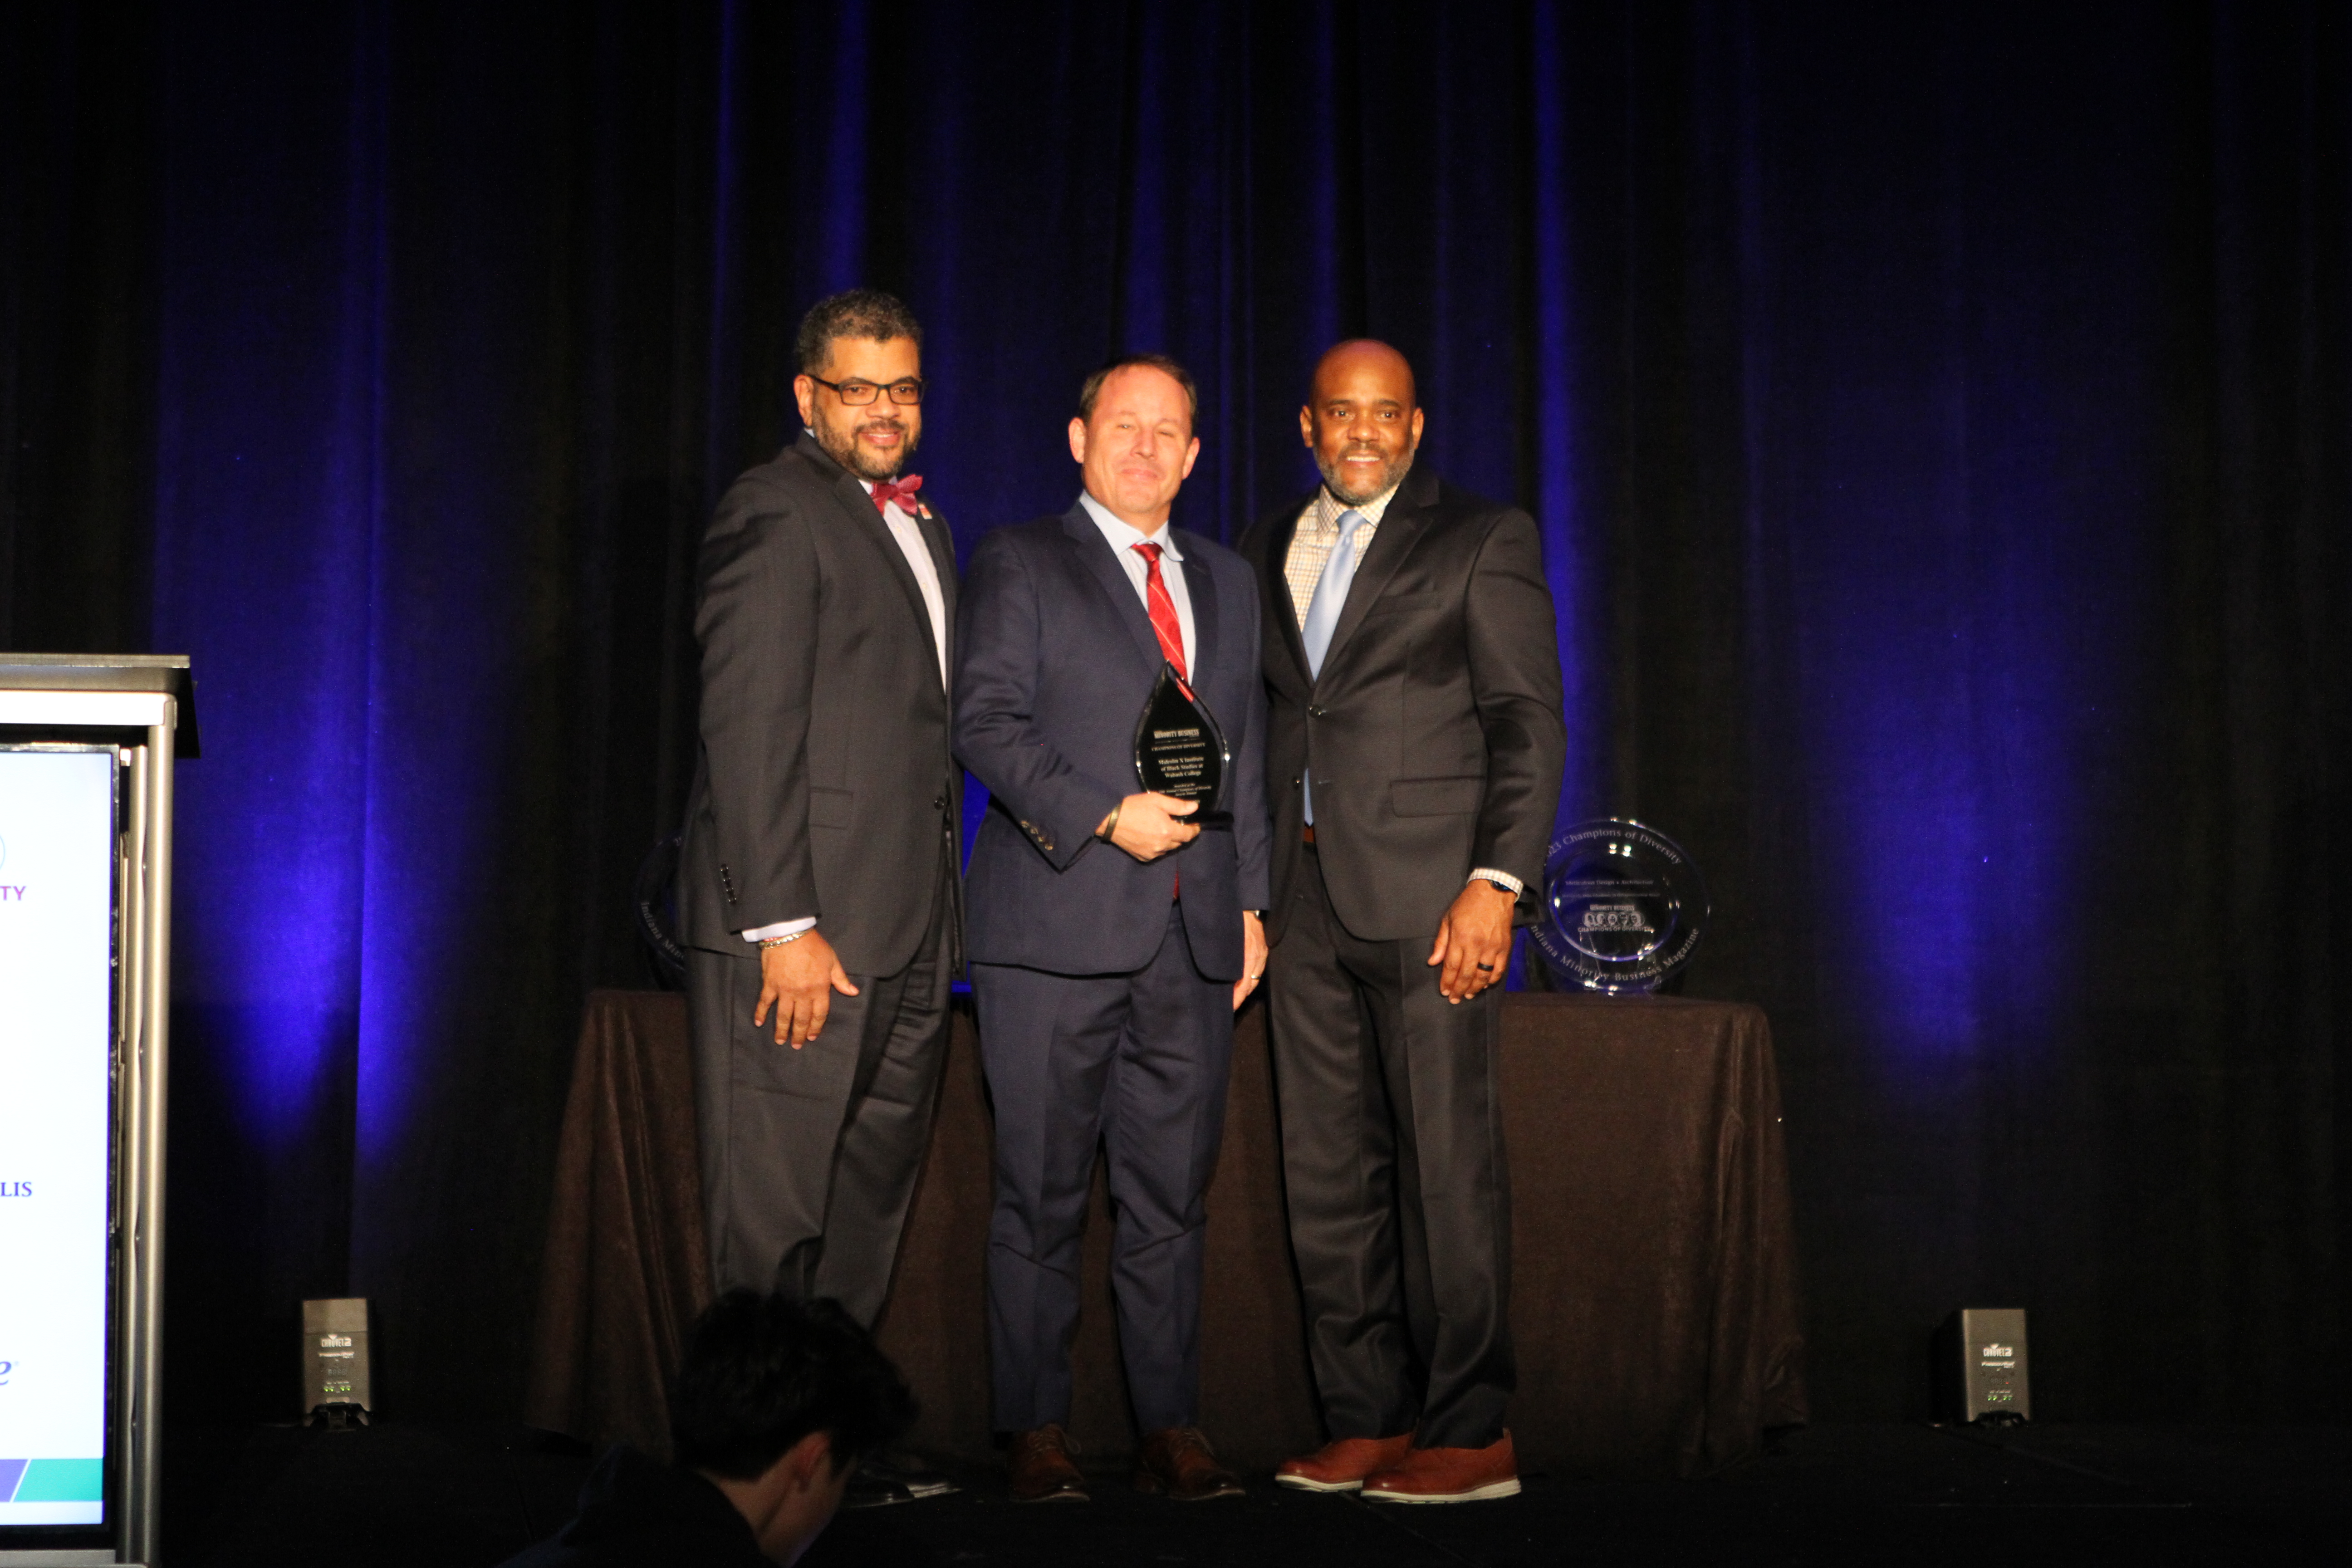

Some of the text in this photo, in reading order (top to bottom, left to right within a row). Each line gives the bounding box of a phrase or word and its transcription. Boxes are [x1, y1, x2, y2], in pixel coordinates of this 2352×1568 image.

[1547, 828, 1682, 864] 23 Champions of Diversity
[1531, 925, 1699, 981] ndiana Minority Business Magazine
[0, 1182, 32, 1197] LIS
